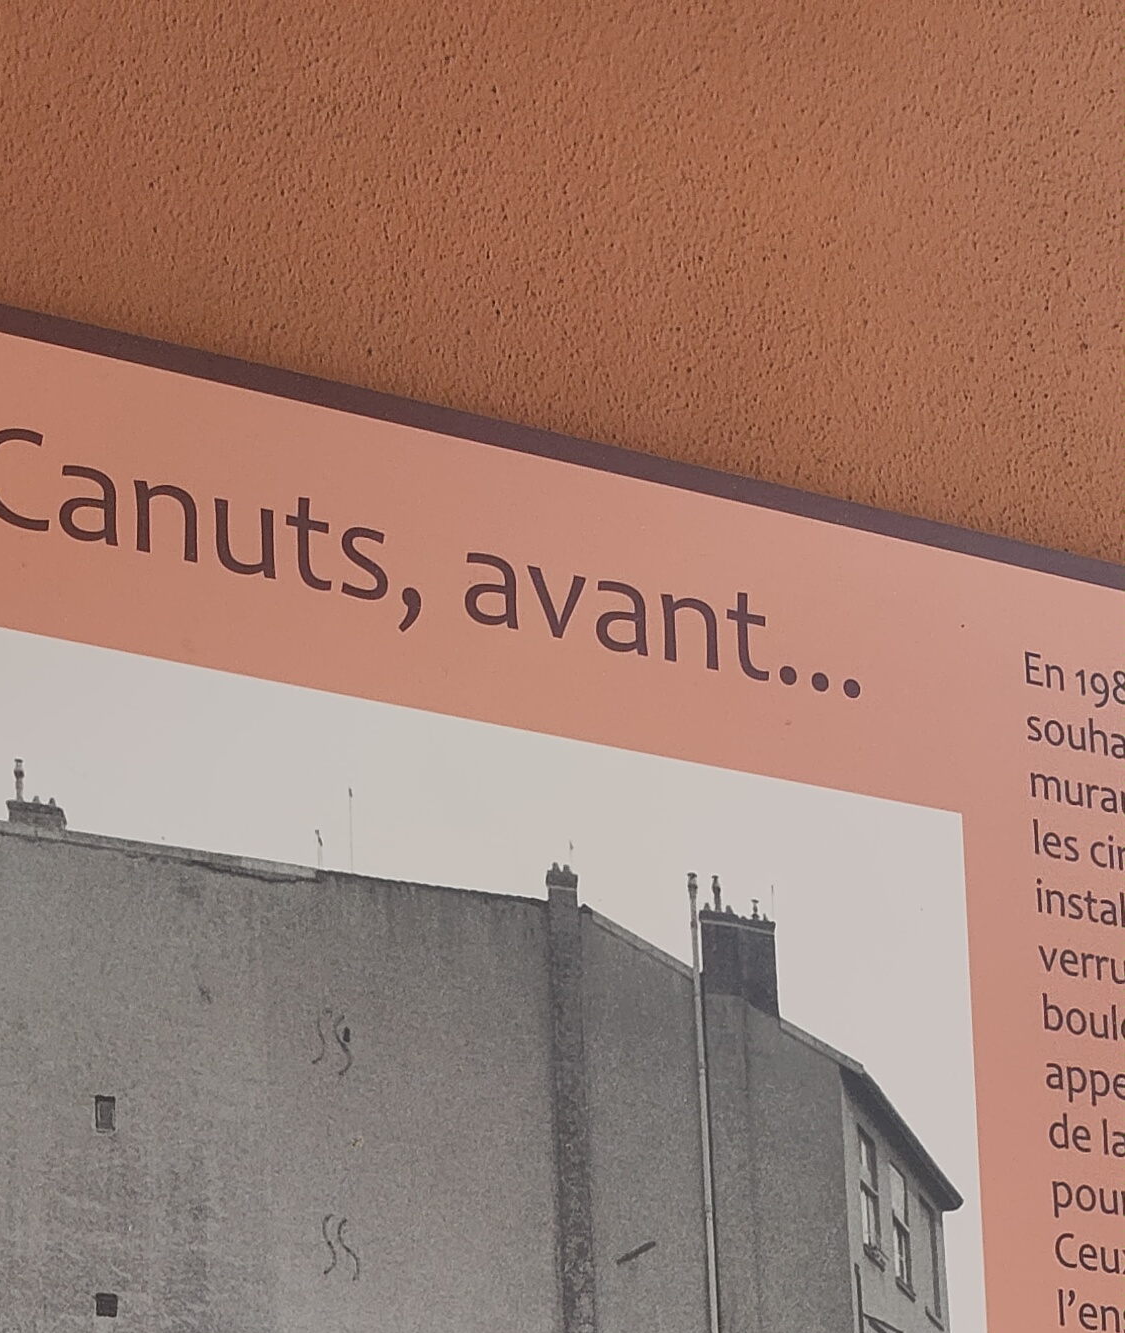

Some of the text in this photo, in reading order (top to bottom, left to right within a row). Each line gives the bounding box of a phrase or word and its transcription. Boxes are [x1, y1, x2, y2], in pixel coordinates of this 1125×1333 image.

[463, 550, 862, 699] avant...
[1024, 651, 1065, 692] En
[1026, 715, 1125, 760] souha
[1030, 772, 1125, 815] mura
[1032, 818, 1080, 862] les
[1042, 993, 1125, 1040] boul
[1049, 1113, 1125, 1158] de la
[1055, 1233, 1125, 1275] Ceu
